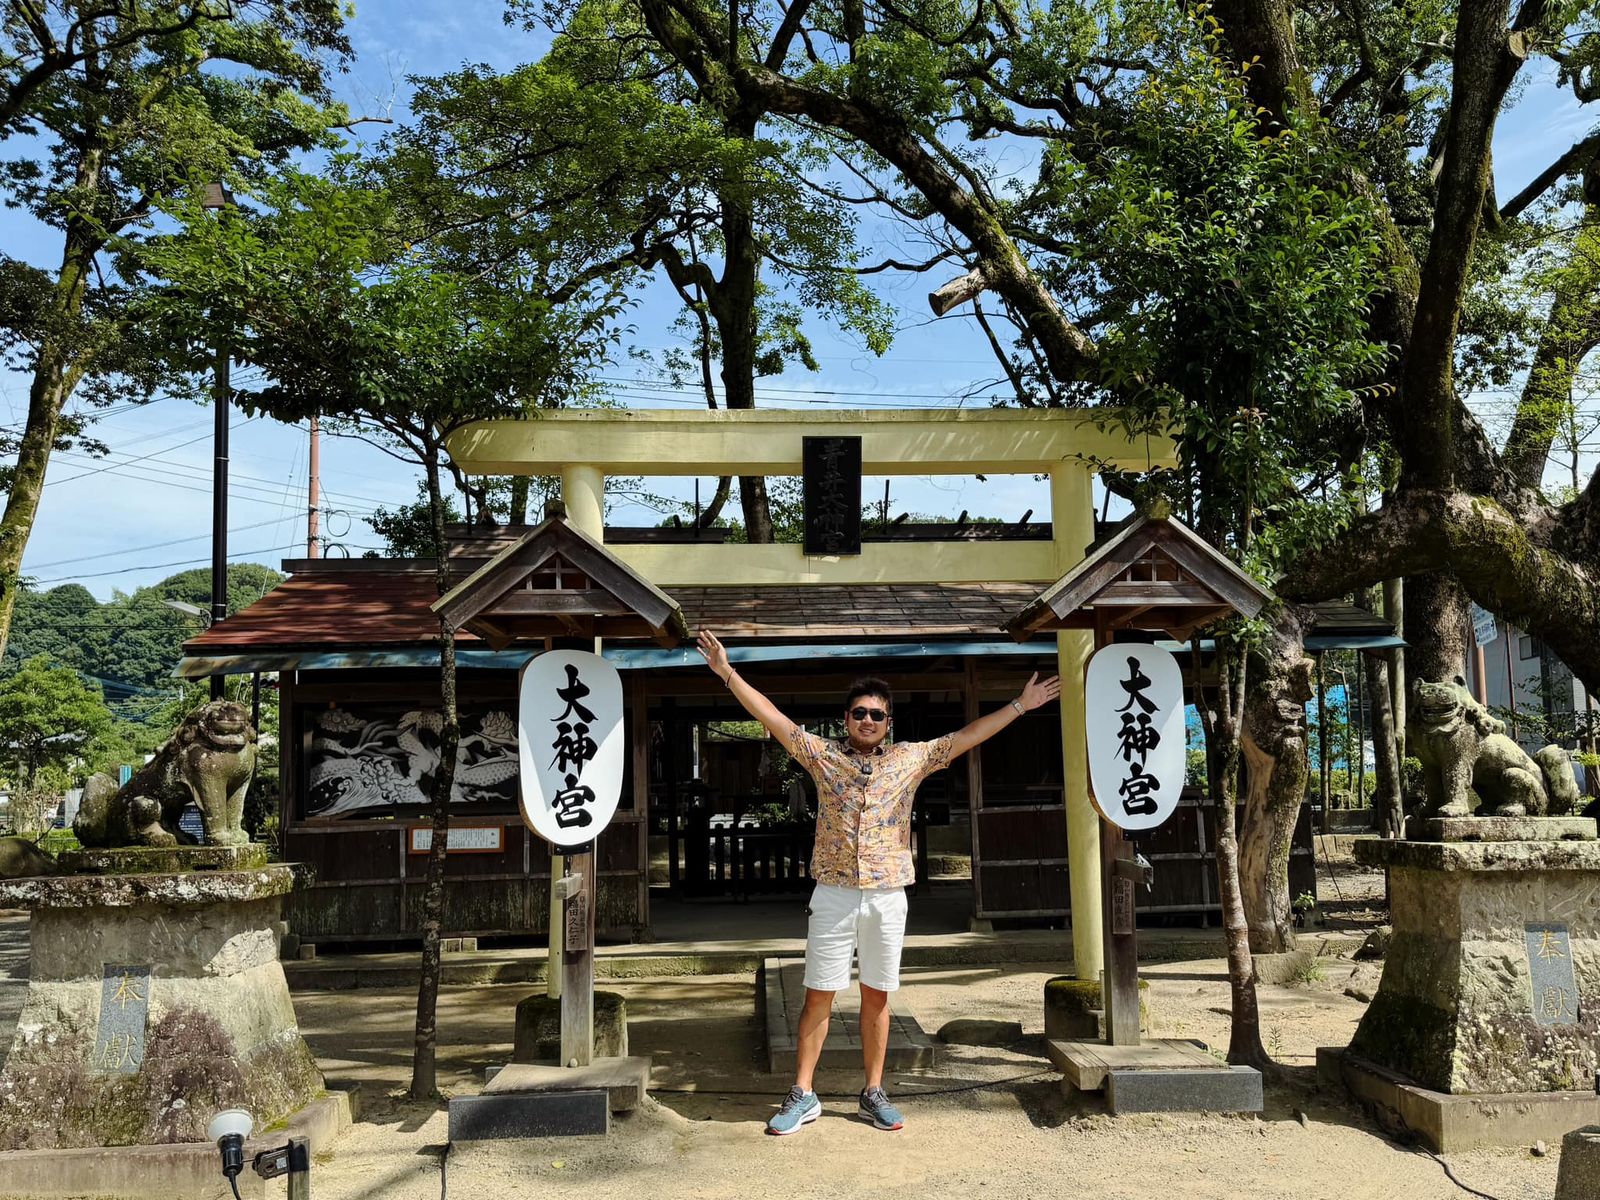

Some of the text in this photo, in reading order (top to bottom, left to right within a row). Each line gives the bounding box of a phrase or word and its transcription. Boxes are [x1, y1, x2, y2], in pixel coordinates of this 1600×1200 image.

[548, 664, 599, 829] 大神宮
[1114, 656, 1161, 816] 大神宮
